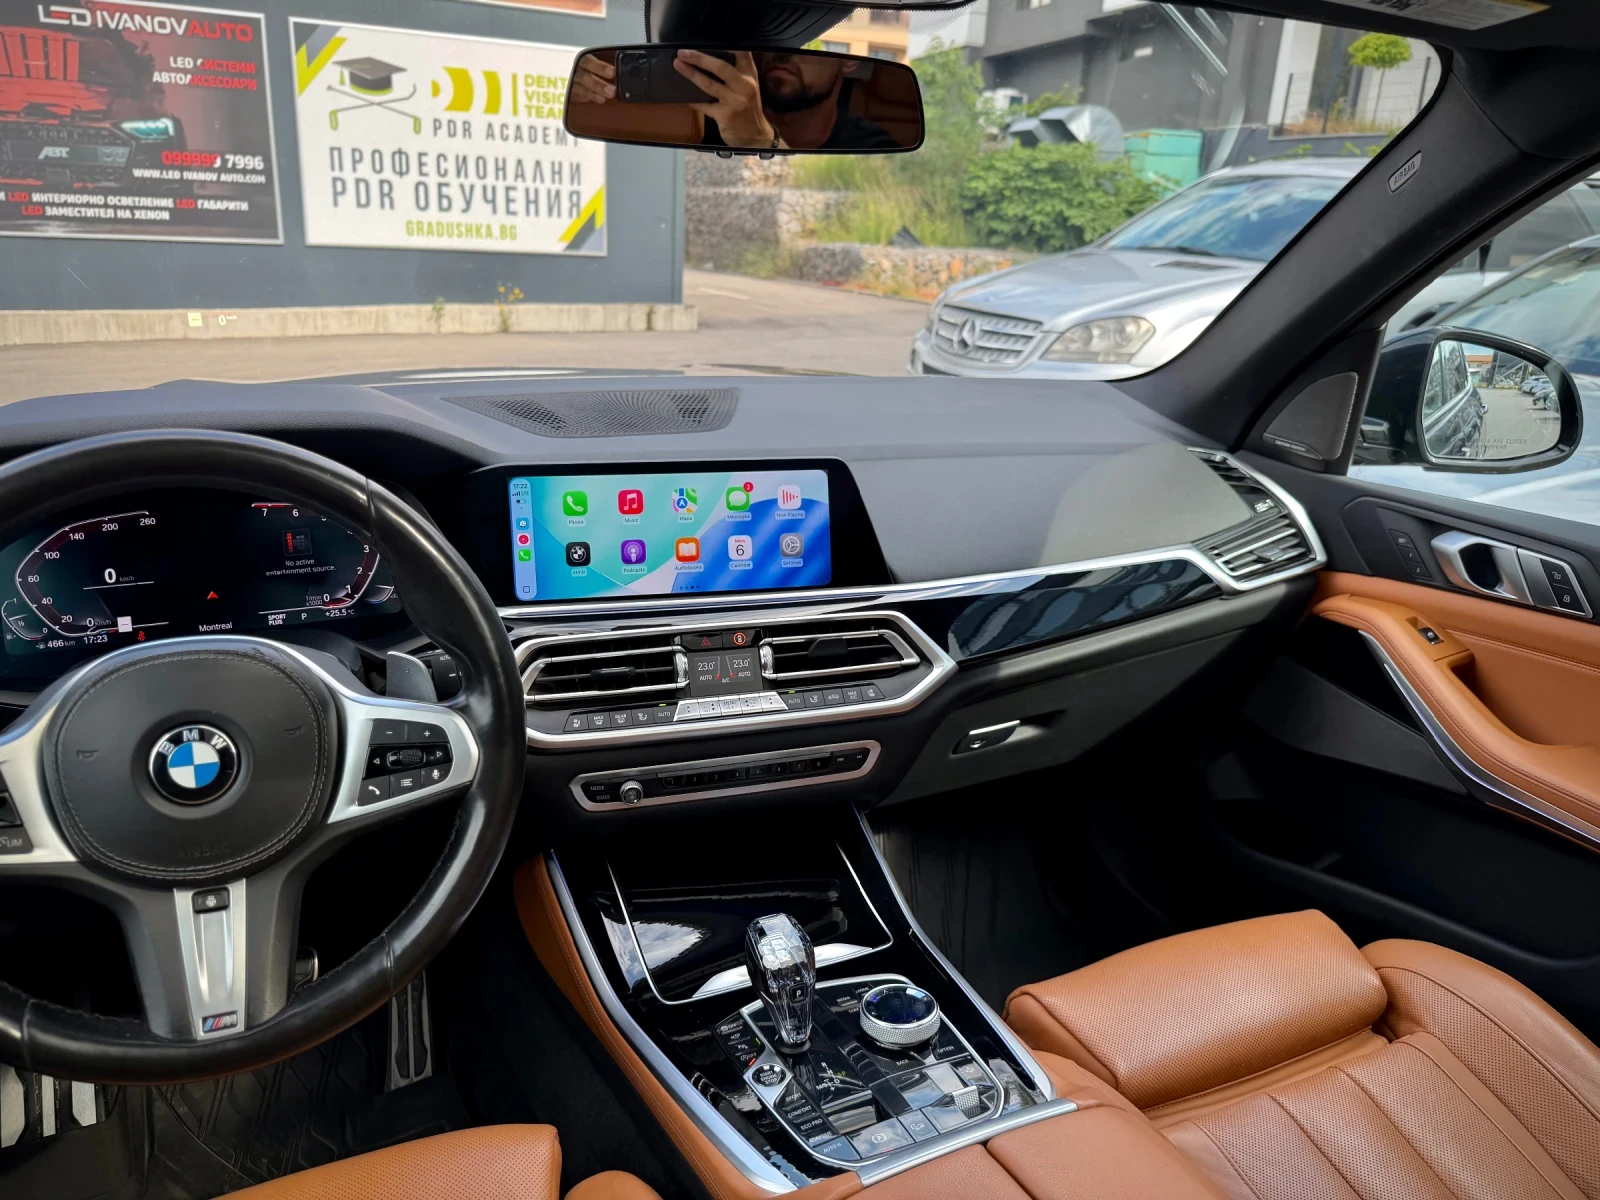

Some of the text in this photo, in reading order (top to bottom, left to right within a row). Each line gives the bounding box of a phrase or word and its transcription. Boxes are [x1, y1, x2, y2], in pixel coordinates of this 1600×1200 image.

[38, 5, 91, 26] LED
[170, 57, 255, 73] LED СИСТЕМИ
[524, 90, 565, 105] VISIO
[433, 118, 472, 140] PDR
[224, 154, 264, 170] 7996
[330, 147, 582, 186] ПРОФЕСИОНАЛНИ
[8, 192, 29, 202] LED
[32, 193, 104, 205] ИНТЕРИОРНО
[107, 196, 174, 208] ОСВЕТЛЕНИЕ
[176, 199, 195, 209] LED
[197, 200, 248, 211] ГАБАРИТИ
[332, 177, 581, 219] PDR ОБУЧЕНИЯ
[22, 206, 170, 220] LED ЗАМЕСТИТЕЛ НА XENON
[406, 221, 517, 240] GRADUSHKA.BG
[262, 509, 267, 517] 7
[293, 509, 299, 517] 6
[140, 518, 156, 526] 260
[102, 523, 118, 531] 200
[69, 533, 84, 541] 140
[363, 545, 370, 553] 3
[736, 544, 745, 556] 6
[104, 569, 116, 583] 0
[266, 567, 311, 576] entertainment
[28, 575, 40, 583] 60
[345, 585, 351, 593] 1
[42, 597, 53, 605] 40
[324, 594, 330, 602] 0
[325, 609, 347, 617] +25.5
[61, 615, 72, 623] 20
[86, 618, 94, 628] 0
[199, 622, 232, 632] Montreal
[47, 640, 64, 648] 466
[83, 635, 108, 644] 17:23
[159, 729, 227, 756] BMW
[788, 1105, 811, 1118] COMFORT
[824, 1144, 836, 1153] AUTO
